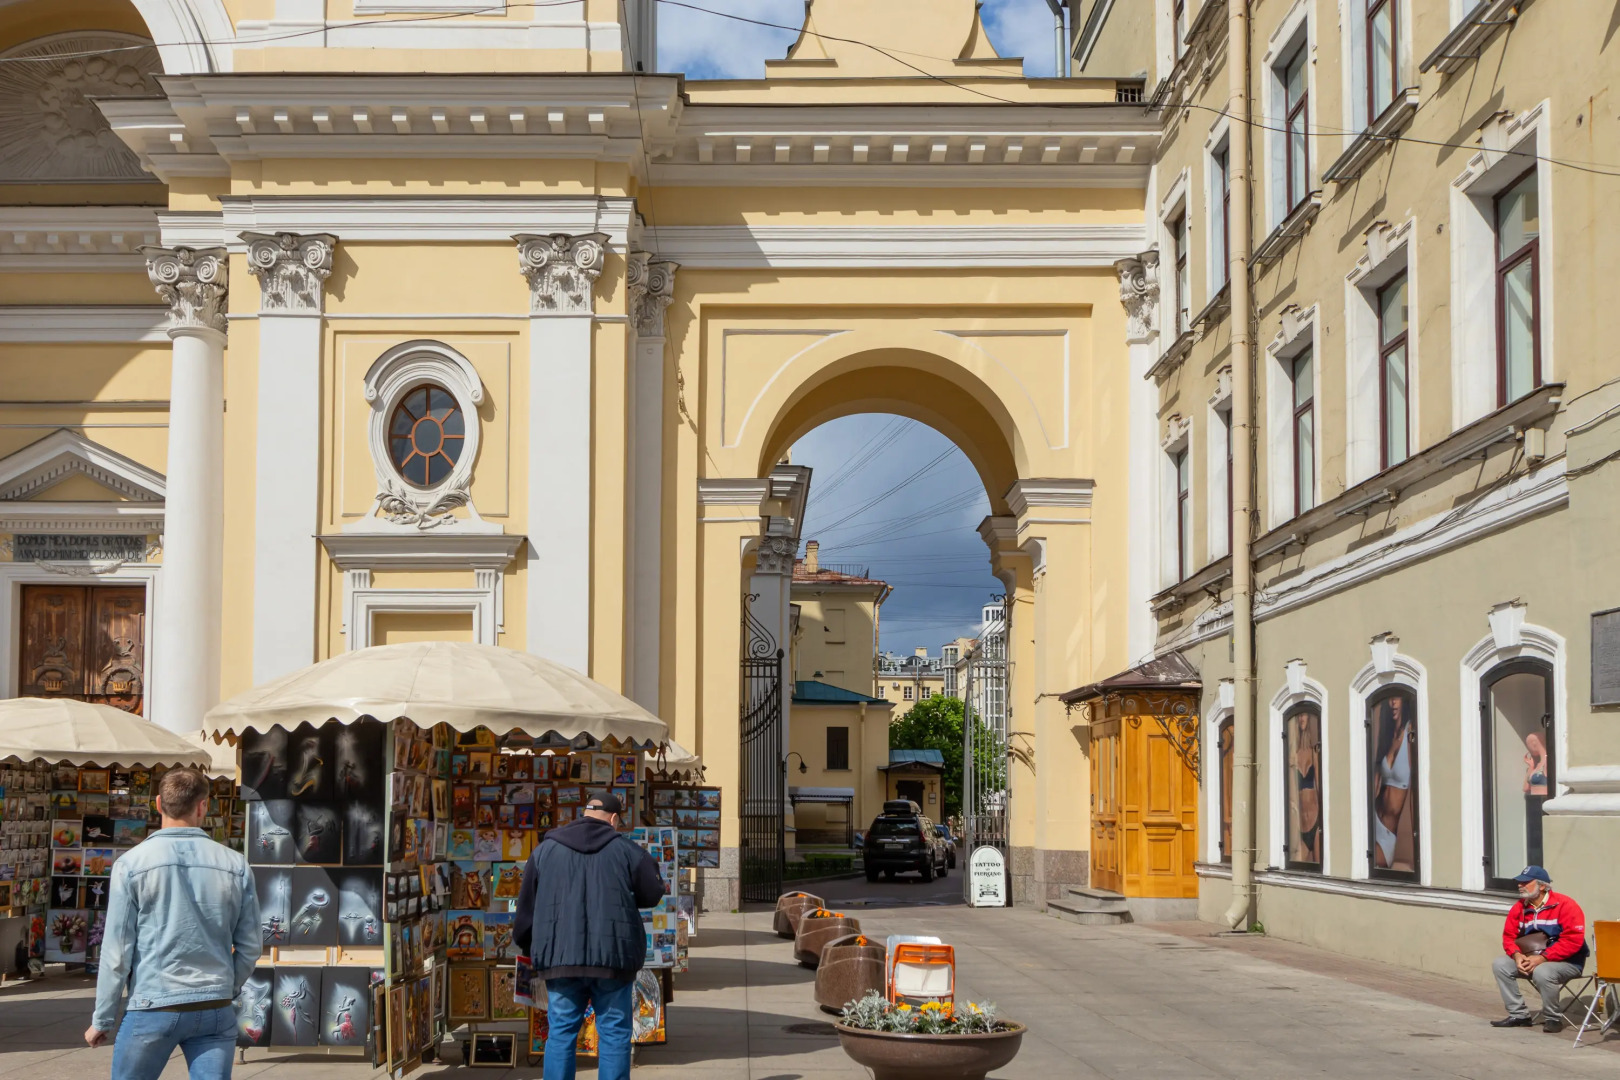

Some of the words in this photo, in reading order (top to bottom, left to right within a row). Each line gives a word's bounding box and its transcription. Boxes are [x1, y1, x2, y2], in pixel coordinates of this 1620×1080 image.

[18, 535, 47, 546] DOMUS
[49, 535, 68, 547] MEA
[70, 535, 99, 546] DOMUS
[19, 549, 41, 560] ANNO
[128, 550, 142, 560] DIE
